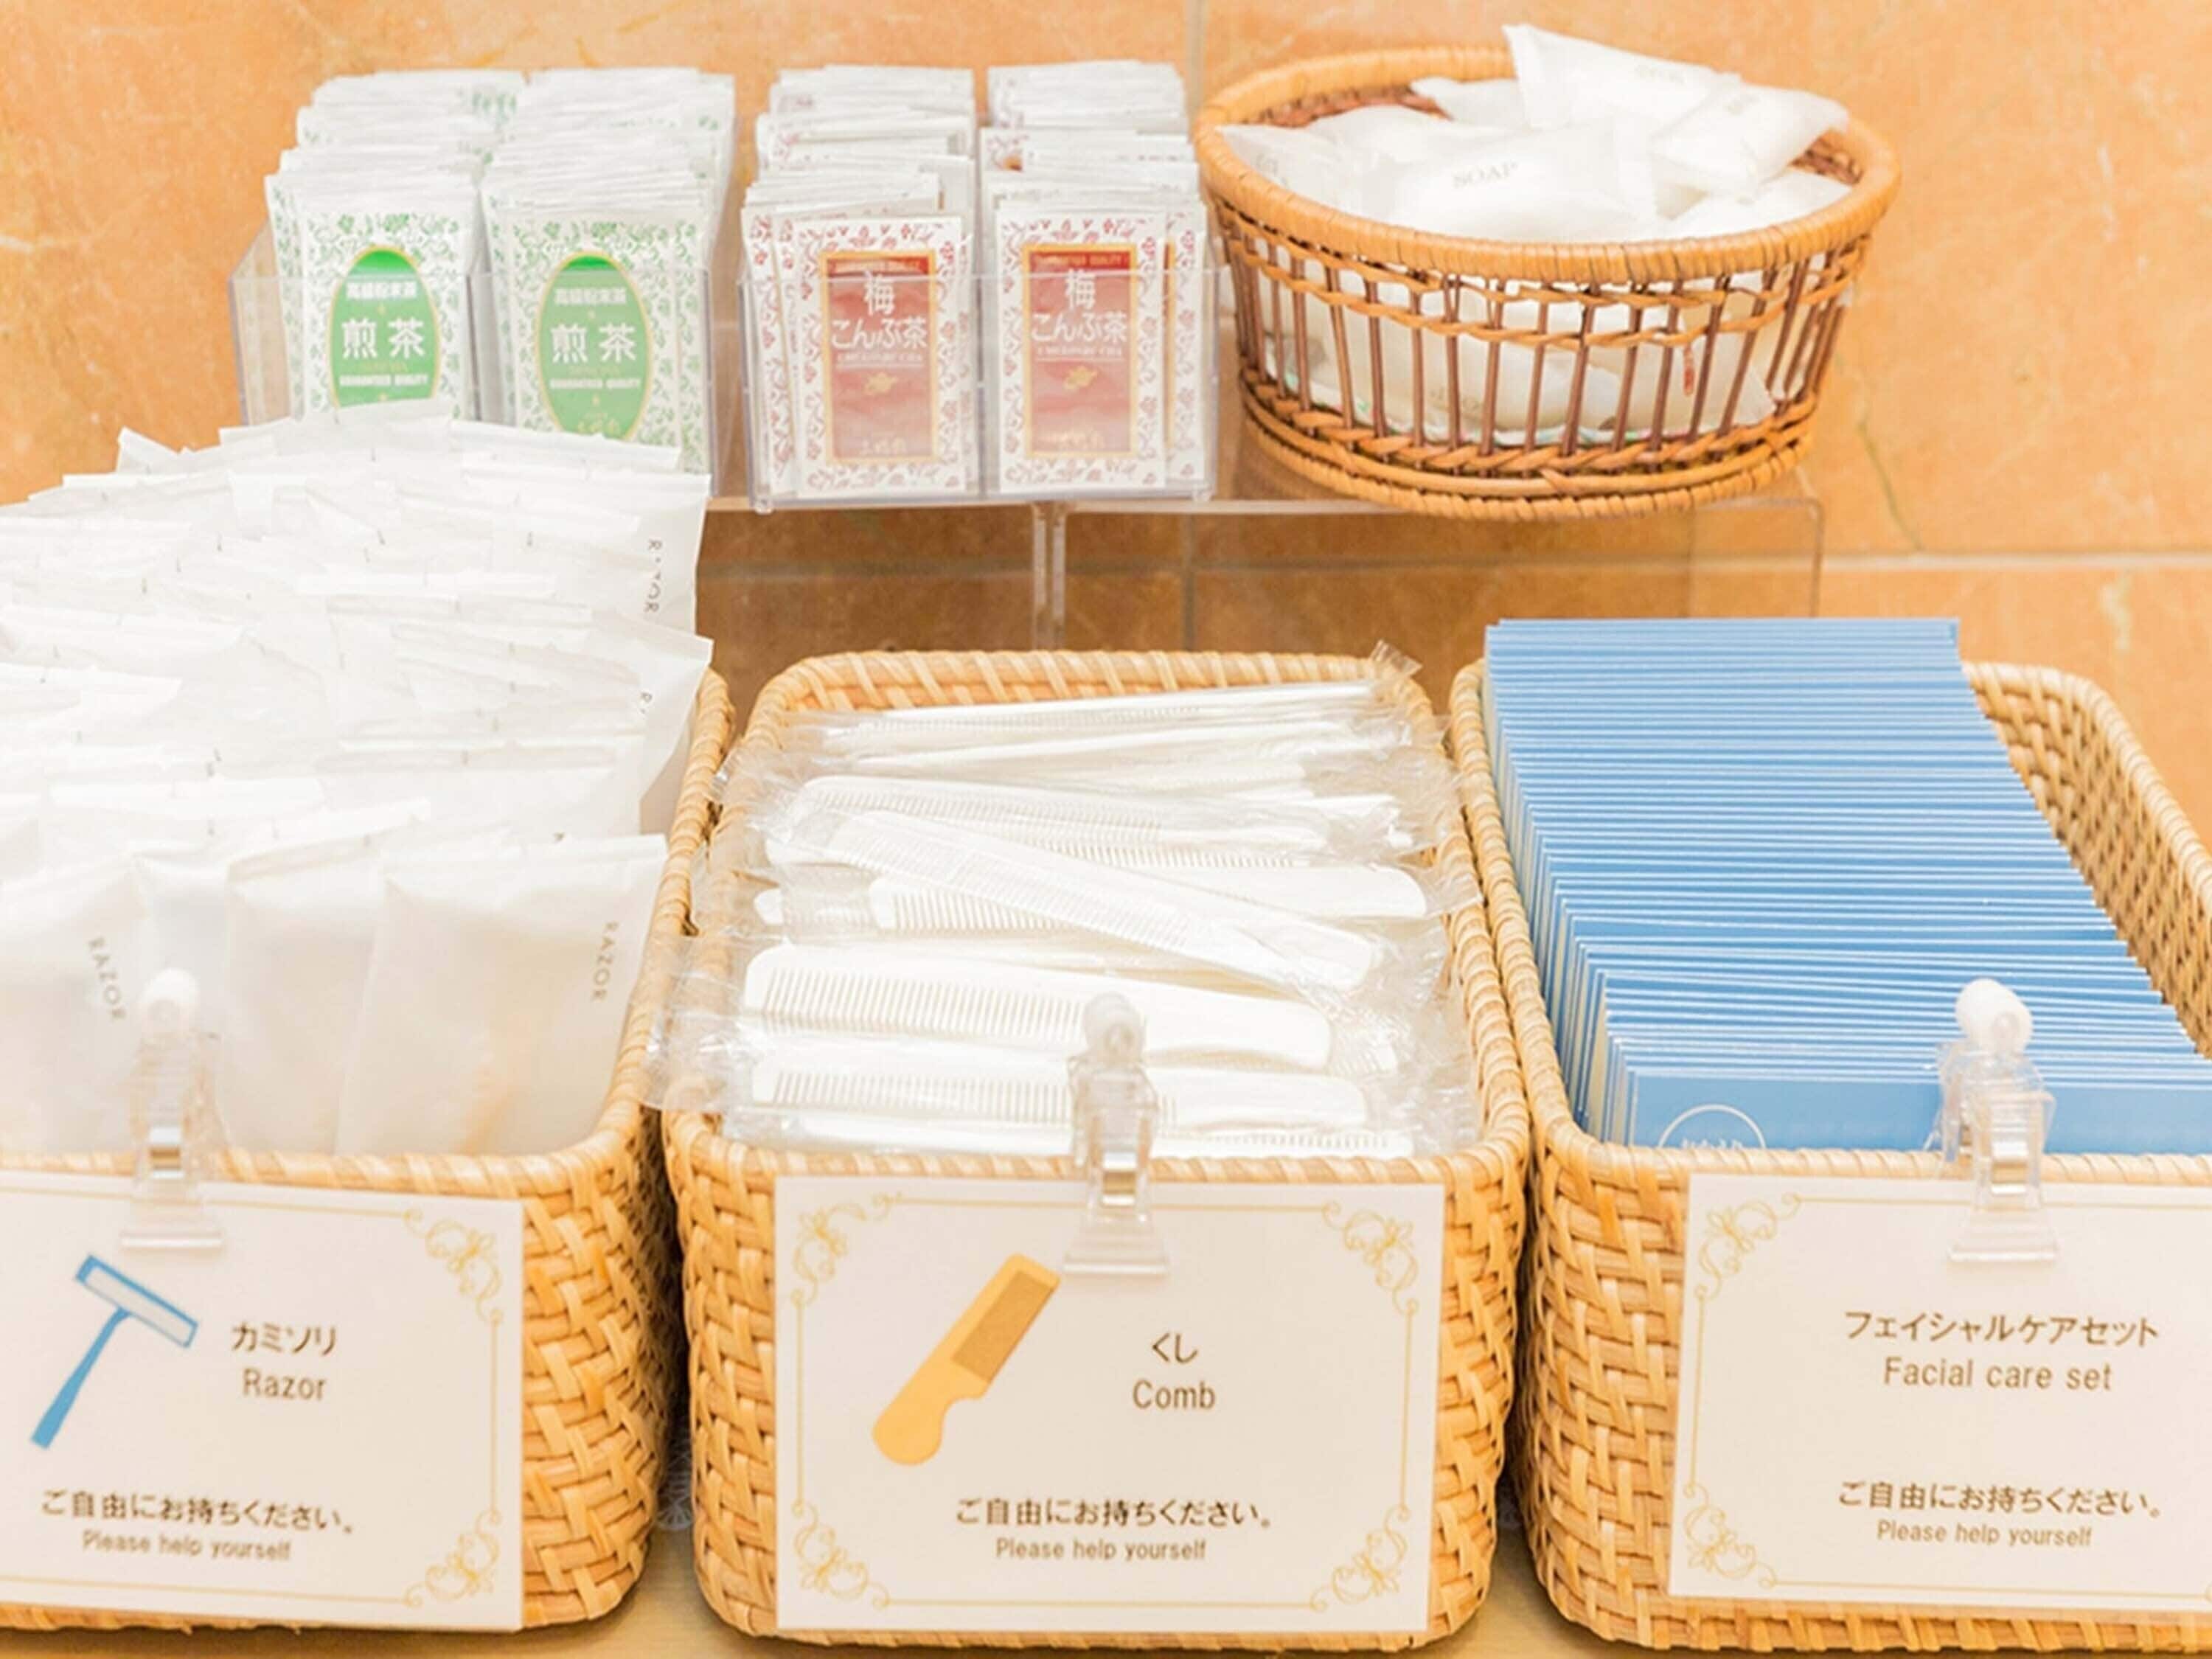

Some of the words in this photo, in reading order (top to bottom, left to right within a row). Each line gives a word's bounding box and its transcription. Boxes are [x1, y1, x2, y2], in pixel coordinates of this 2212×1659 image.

[863, 271, 895, 316] 梅
[1064, 268, 1096, 311] 梅
[341, 318, 425, 358] 煎茶
[550, 323, 636, 364] 煎茶
[831, 316, 928, 349] こんぶ茶
[1032, 310, 1127, 343] こんぶ茶
[592, 921, 619, 1001] RAZOR
[88, 936, 128, 1023] RAZOR
[232, 1322, 337, 1357] カミソリ
[1845, 1311, 2159, 1348] フェイシャルケアセット
[1151, 1332, 1199, 1365] くし
[243, 1368, 327, 1401] Razor
[1883, 1356, 1974, 1388] Facial
[1986, 1364, 2053, 1390] care
[2066, 1363, 2113, 1391] set
[1132, 1380, 1216, 1410] Comb
[42, 1490, 353, 1534] ご自由にお持ちください。
[956, 1497, 1271, 1528] ご自由にお持ちください。
[1837, 1481, 2160, 1519] ご自由にお持ちください。
[83, 1528, 151, 1554] Please
[159, 1533, 204, 1558] help
[210, 1537, 293, 1562] yourself
[995, 1537, 1065, 1559] Please
[1073, 1538, 1117, 1562] help
[1124, 1538, 1207, 1562] yourself
[1877, 1518, 1947, 1543] Please
[1955, 1521, 2000, 1547] help
[2008, 1526, 2093, 1548] yourself
